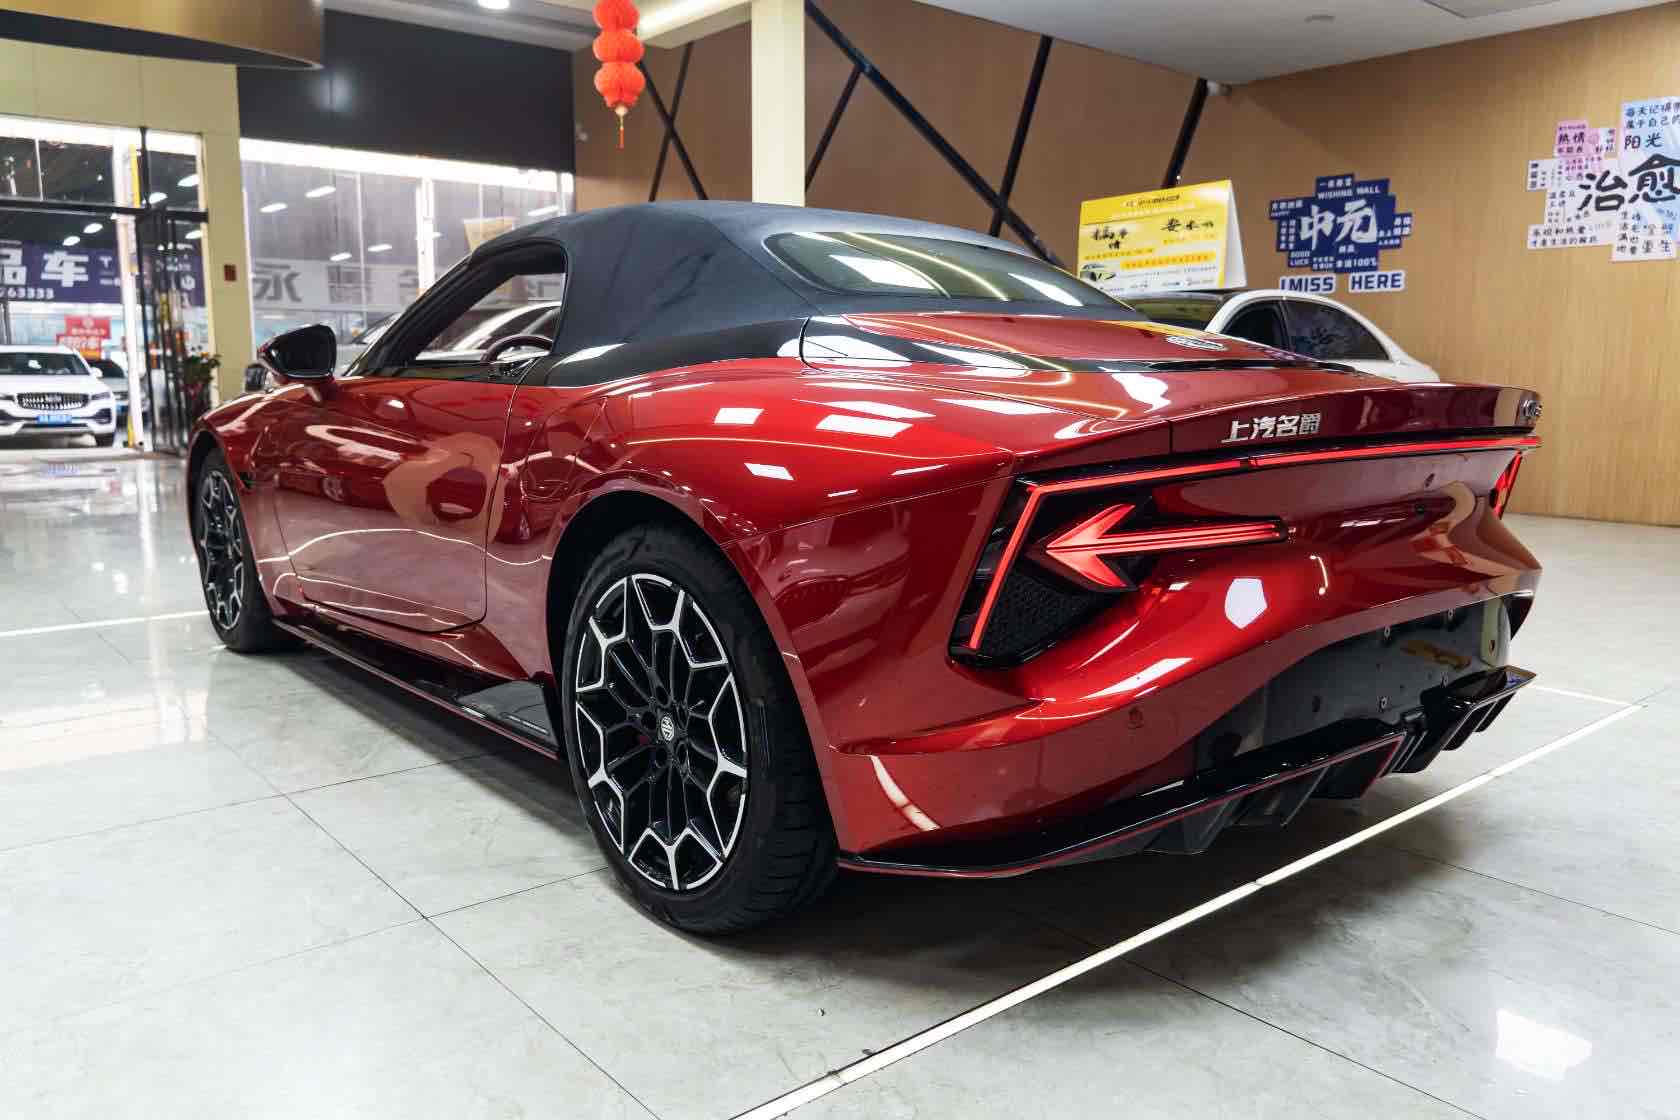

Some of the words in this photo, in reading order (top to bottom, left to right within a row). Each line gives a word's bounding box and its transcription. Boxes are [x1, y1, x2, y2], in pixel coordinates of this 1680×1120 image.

[1624, 132, 1663, 150] 阳光
[1356, 184, 1380, 195] WALL
[1577, 153, 1680, 211] 治愈
[1351, 272, 1403, 291] HERE
[1220, 412, 1321, 443] 上汽名爵
